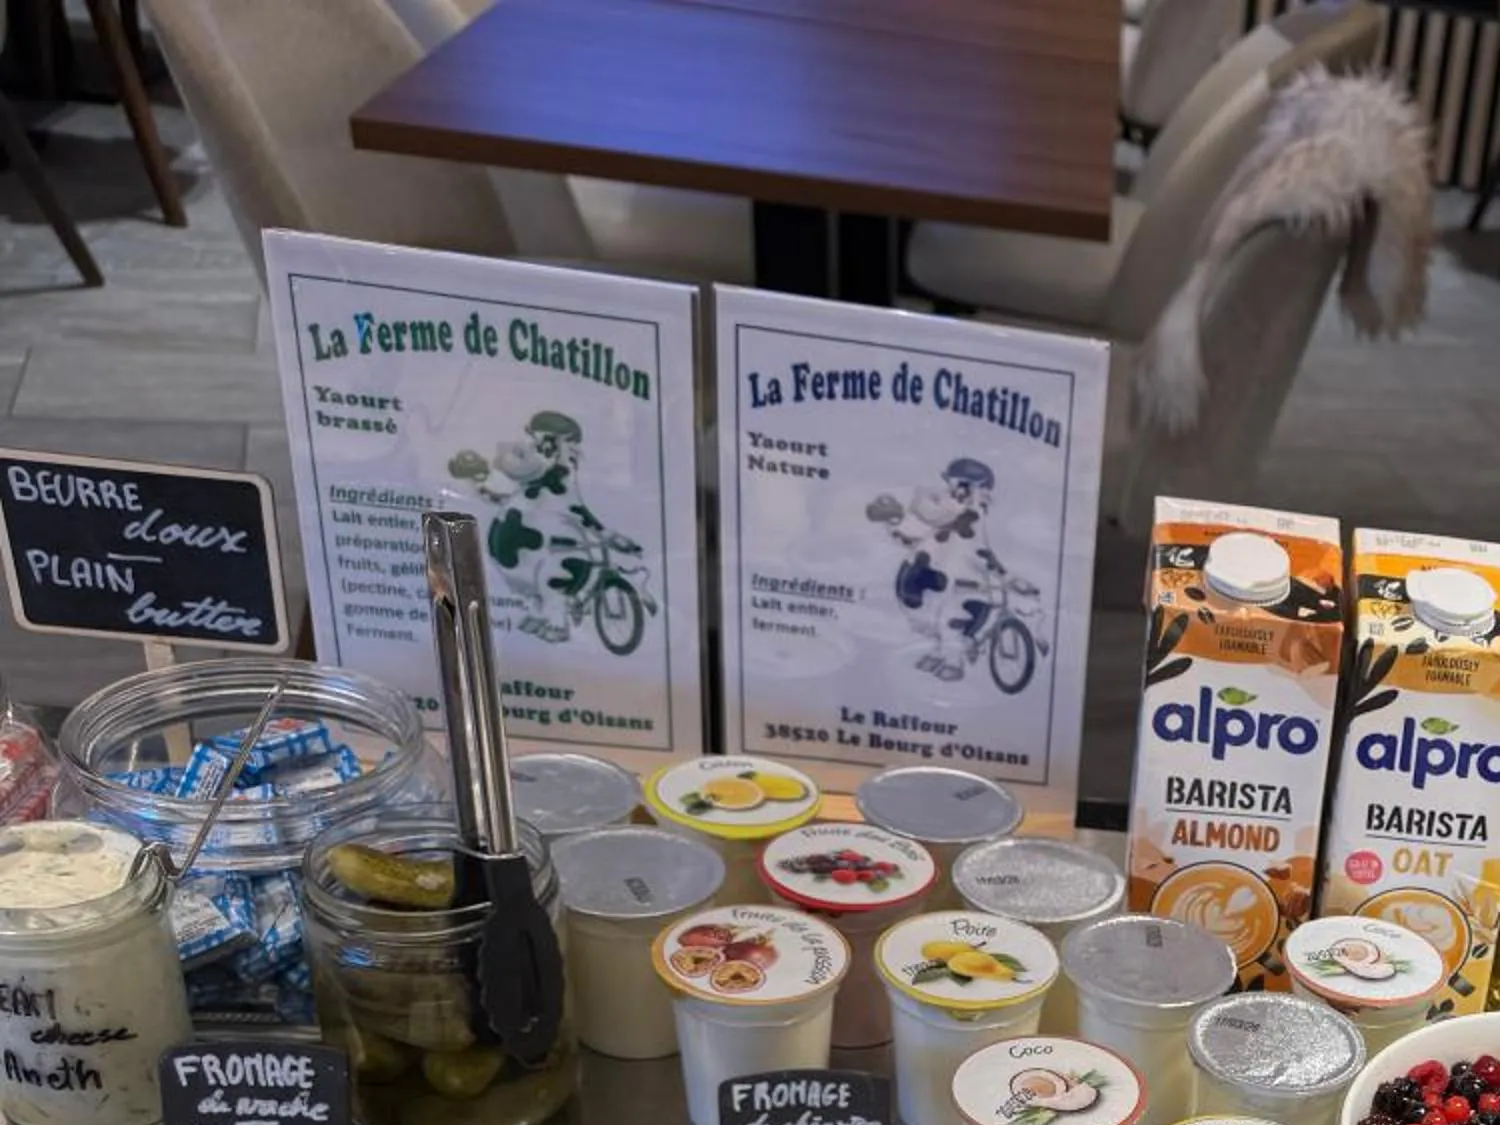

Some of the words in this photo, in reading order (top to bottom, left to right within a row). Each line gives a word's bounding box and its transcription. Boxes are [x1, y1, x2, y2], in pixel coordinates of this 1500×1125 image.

[309, 323, 347, 360] La
[355, 312, 452, 354] Ferme
[464, 311, 498, 356] de
[509, 318, 650, 399] Chatillon
[314, 386, 404, 411] Yaourt
[748, 372, 783, 409] La
[791, 362, 881, 402] Ferme
[892, 362, 925, 405] de
[933, 368, 1062, 448] Chatillon
[317, 410, 397, 435] brassé
[748, 432, 829, 457] Yaourt
[747, 455, 830, 480] Nature
[8, 466, 142, 511] BEURRE
[124, 509, 247, 553] doux
[336, 535, 425, 552] préparatio
[26, 549, 135, 594] PLAIN
[126, 592, 262, 636] butter
[501, 680, 575, 701] affour
[840, 706, 865, 726] Le
[873, 710, 958, 737] Raffour
[1152, 685, 1319, 761] alpro
[837, 728, 861, 746] Le
[869, 731, 933, 759] Bourg
[941, 741, 1029, 767] d'Oisans
[1165, 776, 1293, 814] BARISTA
[1170, 818, 1281, 853] ALMOND
[1365, 802, 1490, 842] BARISTA
[1392, 846, 1454, 879] OAT
[950, 918, 998, 937] Poire
[1009, 1044, 1053, 1059] Coco
[173, 1052, 316, 1088] FROMAGE
[732, 1079, 852, 1112] FROMAGE
